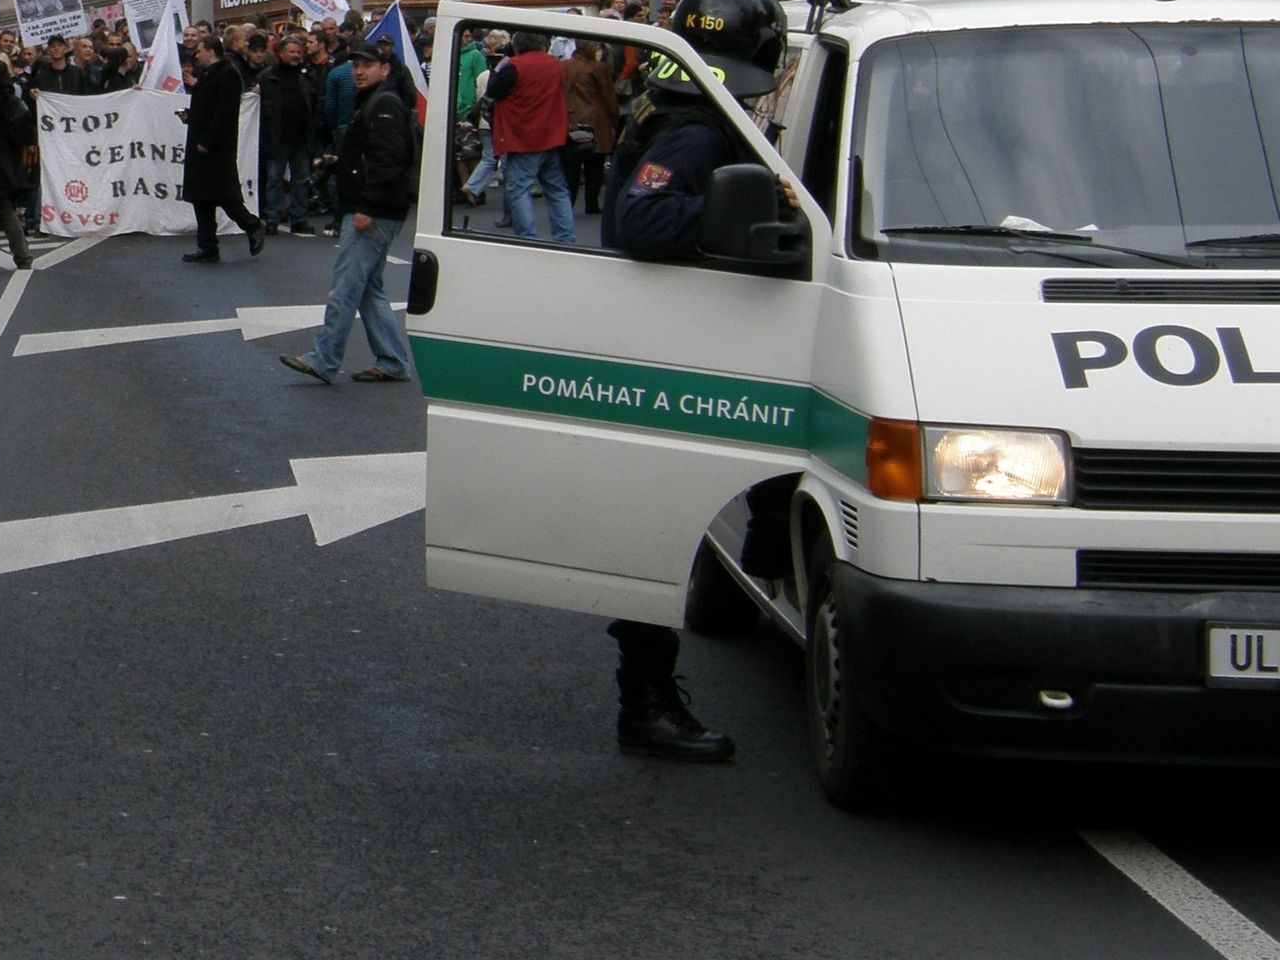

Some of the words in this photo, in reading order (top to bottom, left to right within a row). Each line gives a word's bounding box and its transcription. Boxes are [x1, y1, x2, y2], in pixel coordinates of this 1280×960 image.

[686, 14, 695, 27] K
[699, 16, 724, 31] 150
[40, 112, 120, 133] STOP
[85, 141, 186, 167] ČERNÉ
[41, 203, 120, 226] Sever
[1051, 324, 1280, 389] POL
[523, 373, 646, 408] POMÁHAT
[653, 391, 670, 411] A
[680, 394, 795, 427] CHRÁNIT
[1230, 634, 1279, 673] UL
